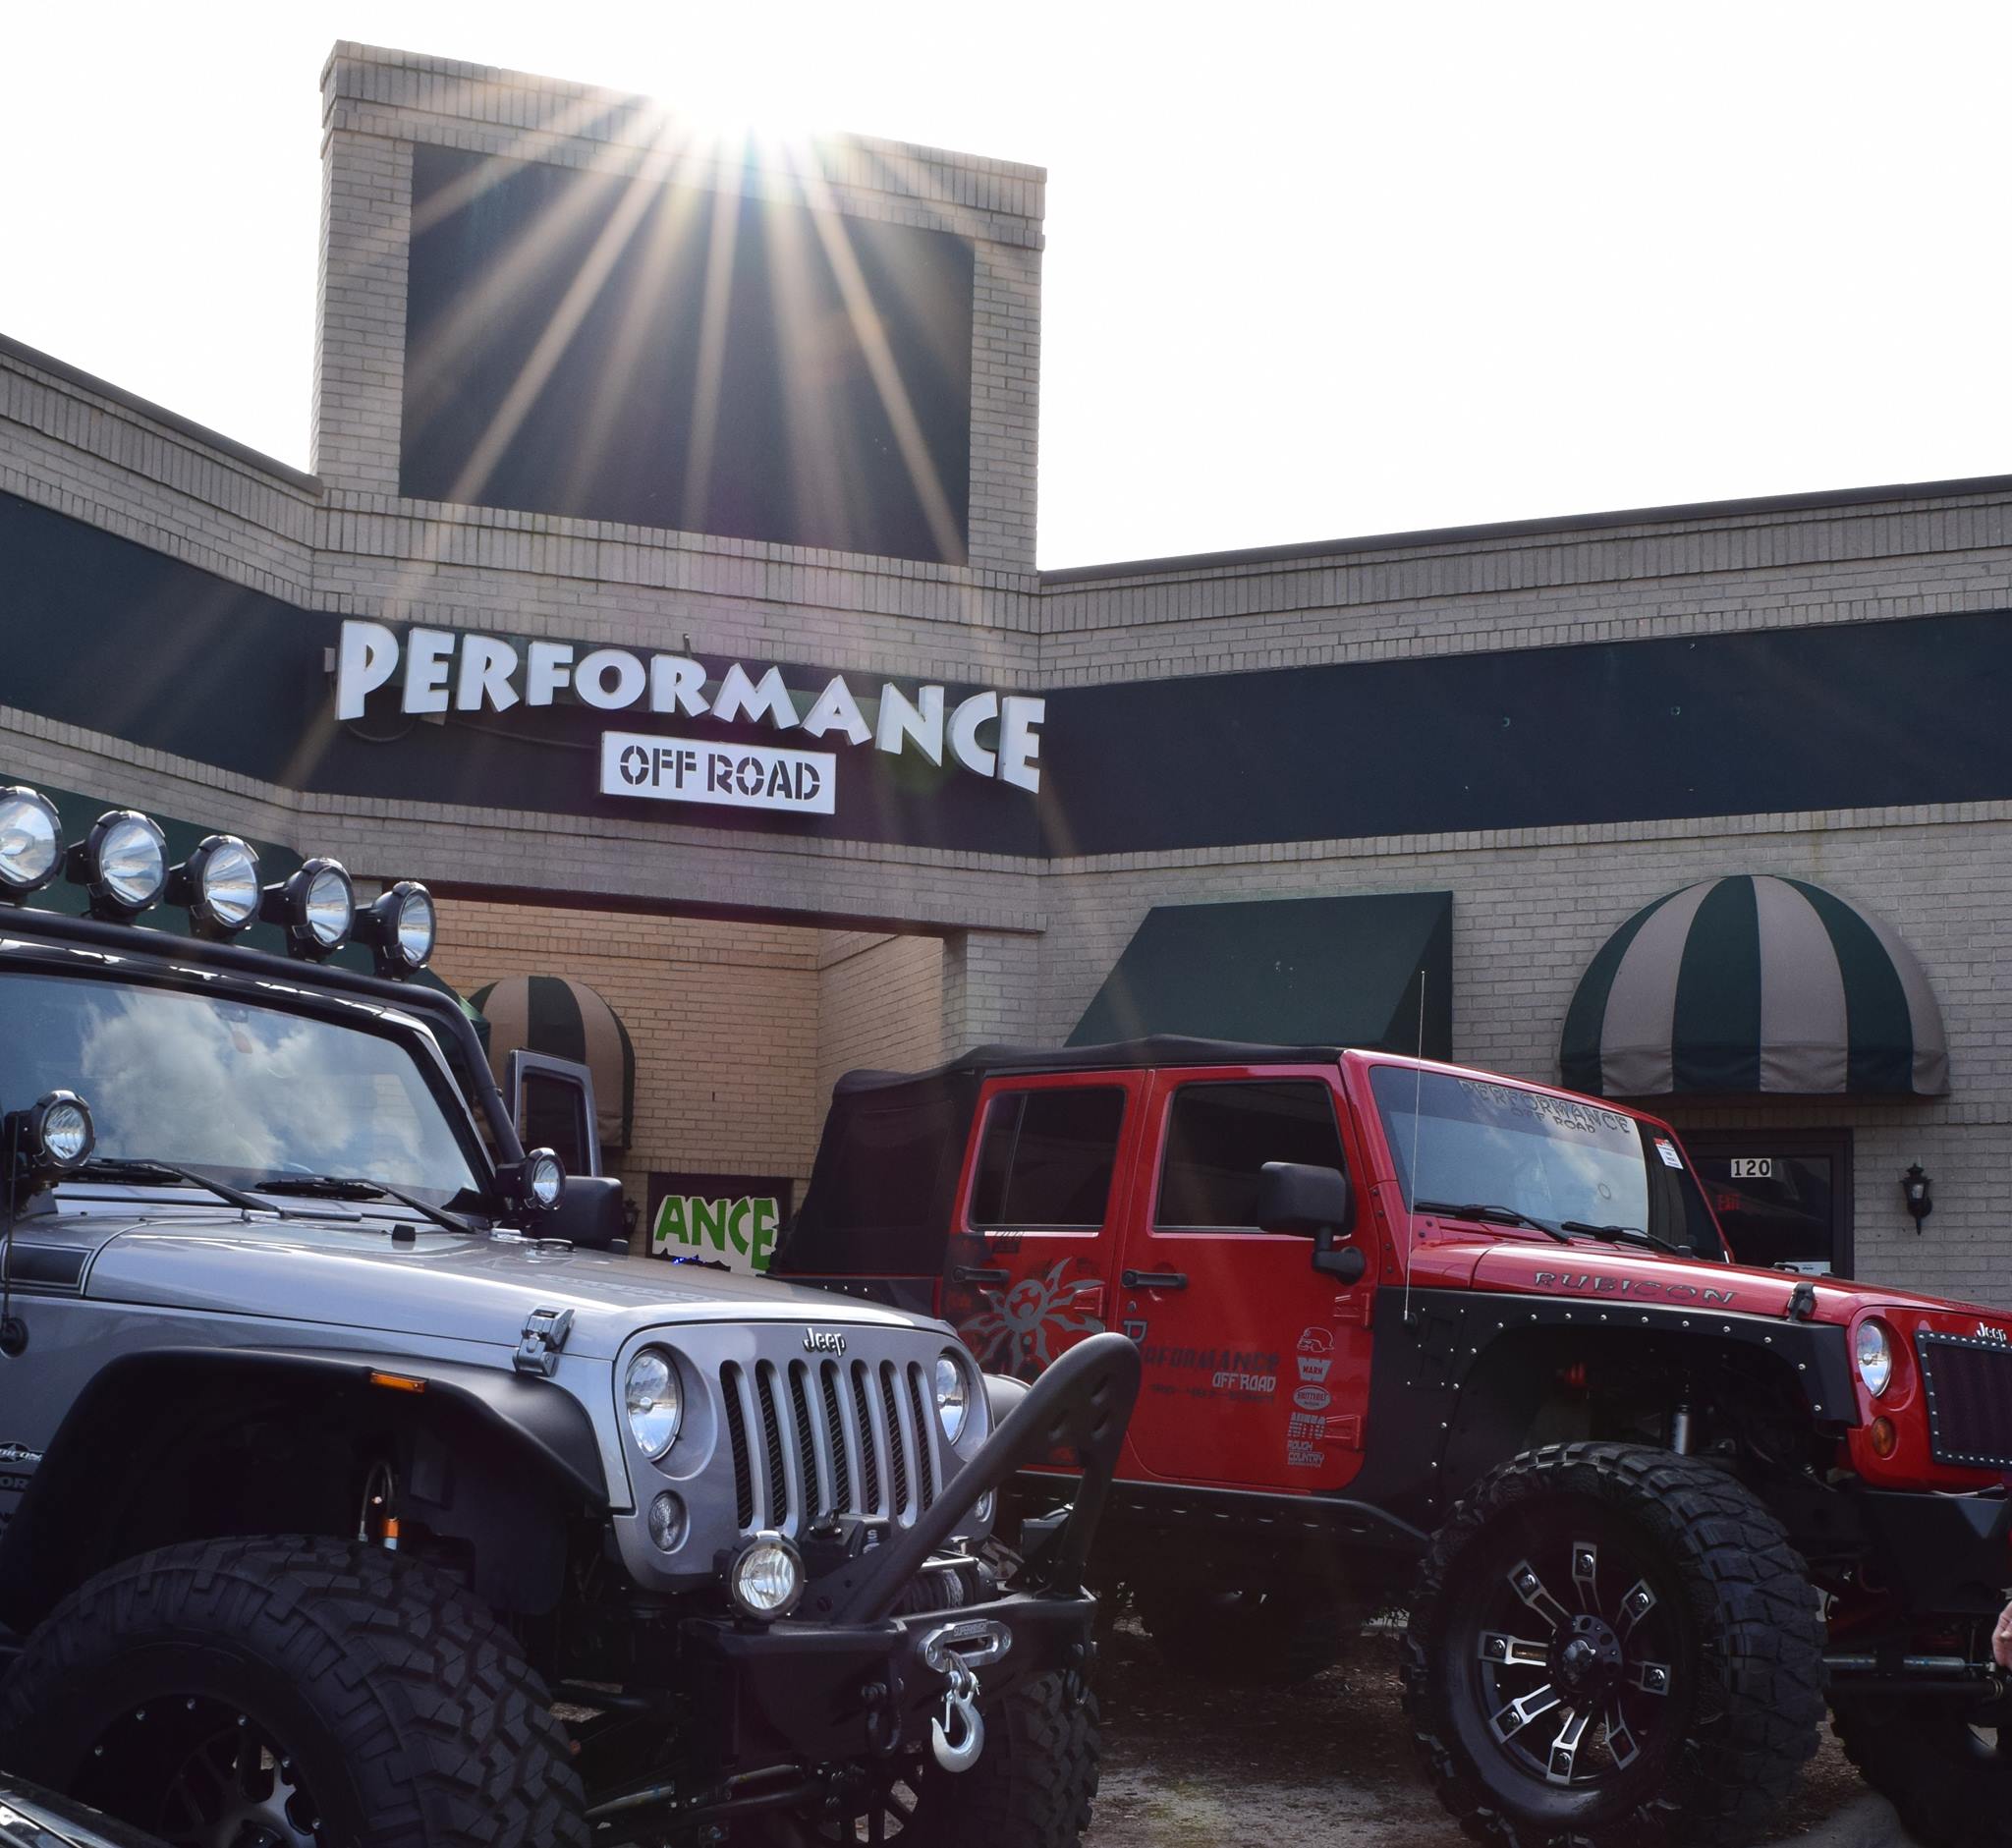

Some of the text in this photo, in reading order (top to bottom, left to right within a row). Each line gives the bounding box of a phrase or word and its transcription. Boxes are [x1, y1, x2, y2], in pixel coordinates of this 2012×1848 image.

[335, 619, 1045, 794] PERFORMANCE
[619, 745, 821, 801] OFF ROAD
[1458, 1079, 1631, 1135] PERFORMANCE
[1555, 1115, 1596, 1134] ROAD
[1733, 1159, 1770, 1177] 120
[1534, 1270, 1738, 1305] RUBICON
[802, 1327, 847, 1357] Jeep
[1975, 1321, 2007, 1342] Jeep
[1212, 1372, 1277, 1392] OFF ROAD
